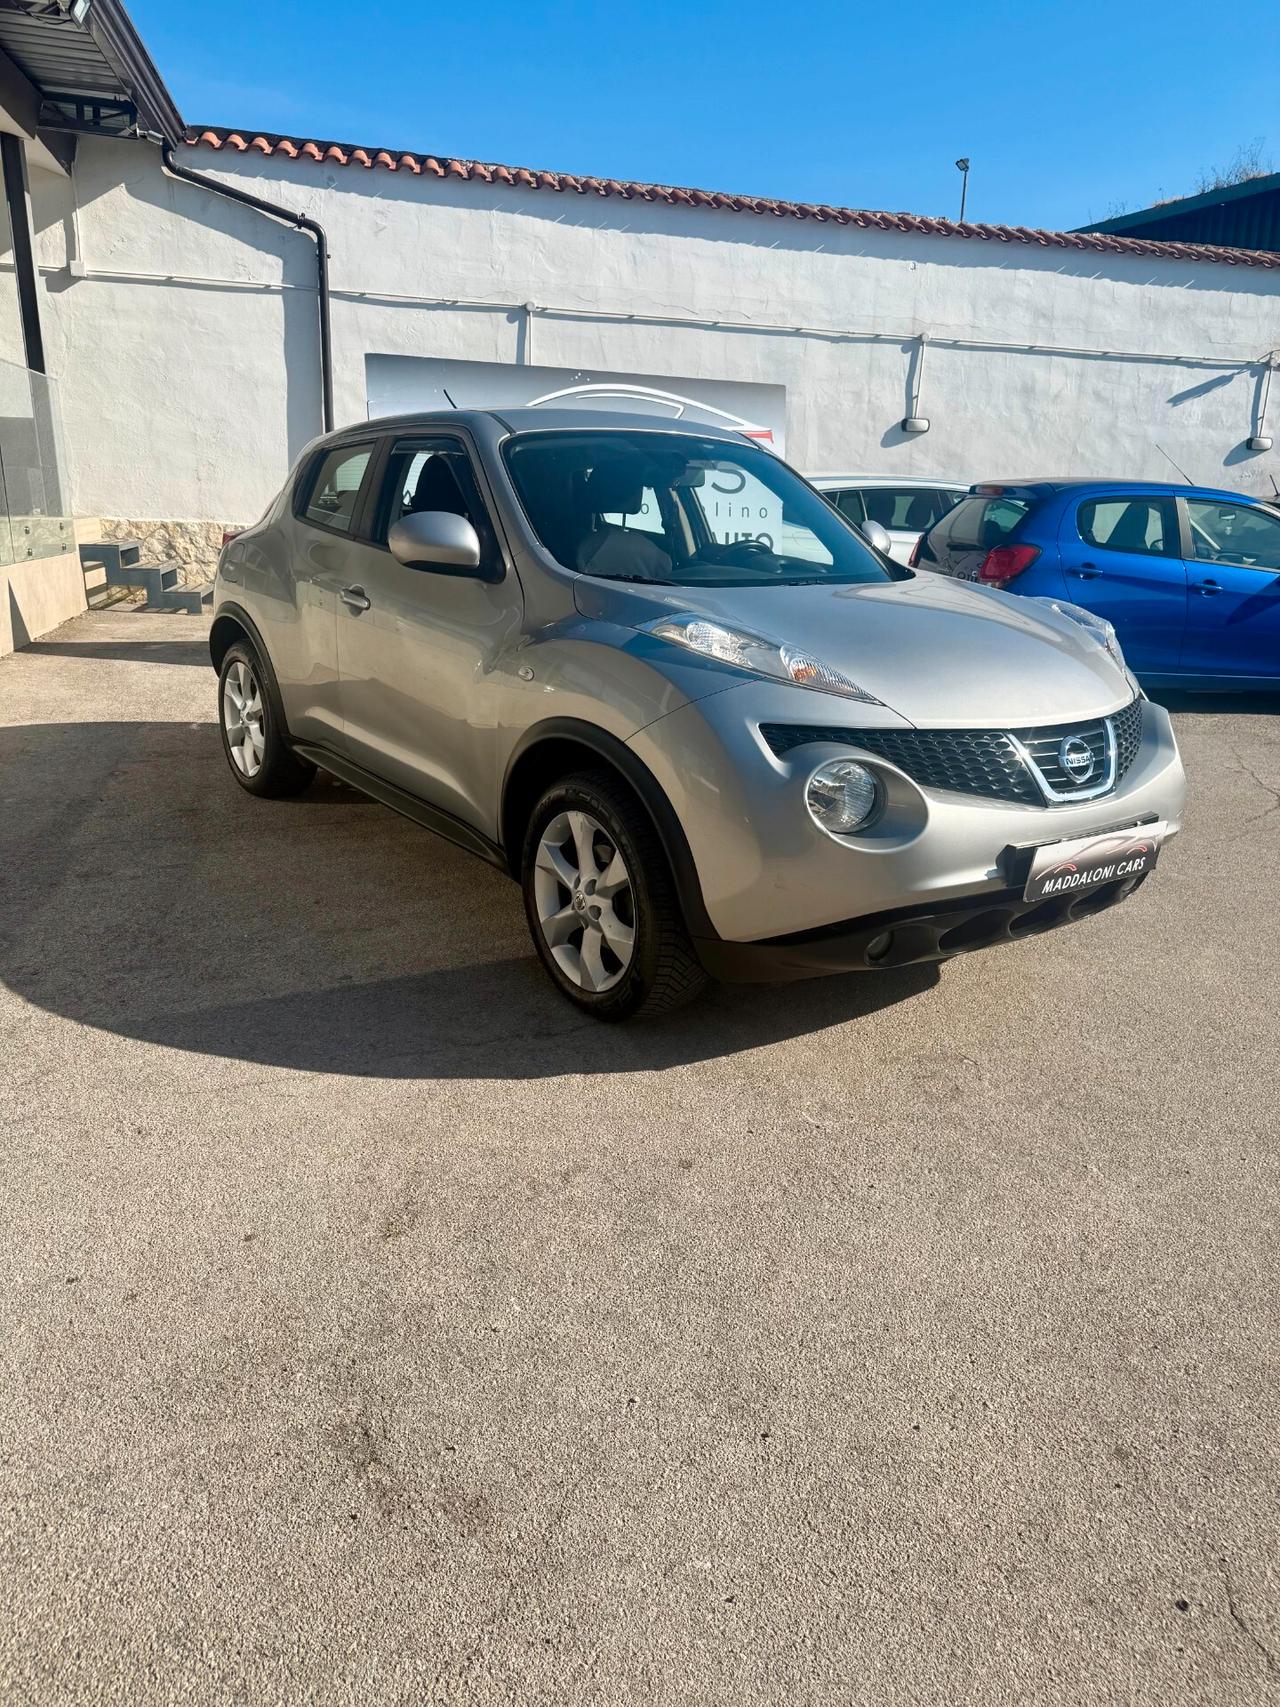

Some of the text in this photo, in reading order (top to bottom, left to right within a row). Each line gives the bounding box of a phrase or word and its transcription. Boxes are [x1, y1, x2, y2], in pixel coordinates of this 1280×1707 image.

[702, 502, 768, 519] lino
[1065, 754, 1092, 766] NISSA
[1041, 857, 1146, 894] MADDALONI CARS
